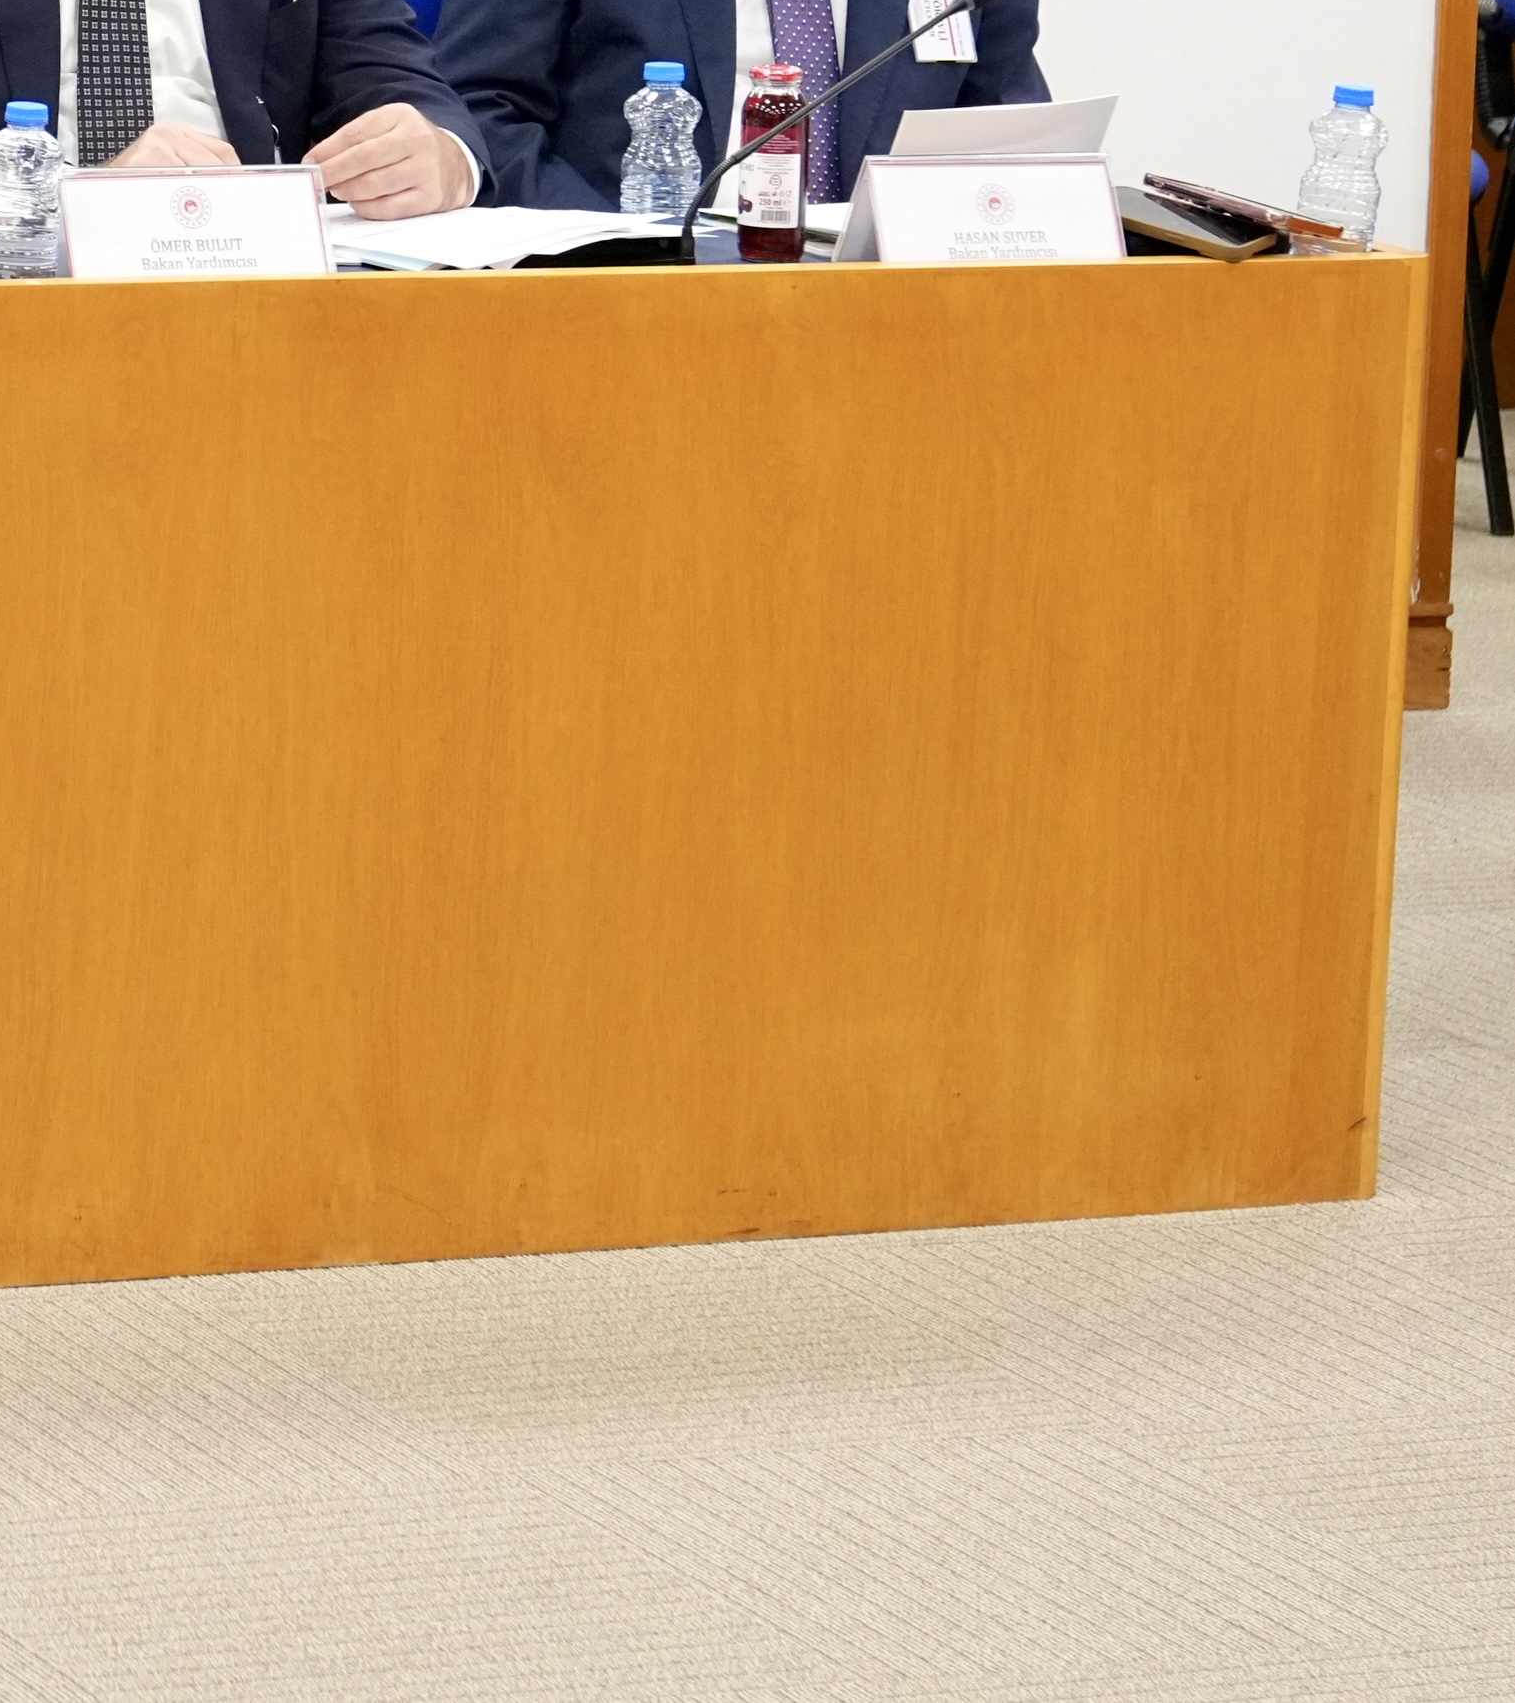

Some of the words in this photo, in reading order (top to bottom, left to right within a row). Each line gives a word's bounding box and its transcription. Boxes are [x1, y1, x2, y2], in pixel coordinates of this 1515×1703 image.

[954, 231, 1000, 244] HASAN
[1003, 230, 1048, 243] SUVER
[150, 238, 193, 253] ÖMER
[196, 238, 242, 252] BULUT
[948, 246, 988, 259] Bakan
[990, 245, 1059, 258] Yardımcısı
[141, 257, 183, 271] Bakan
[185, 255, 258, 270] Yardımcısı
